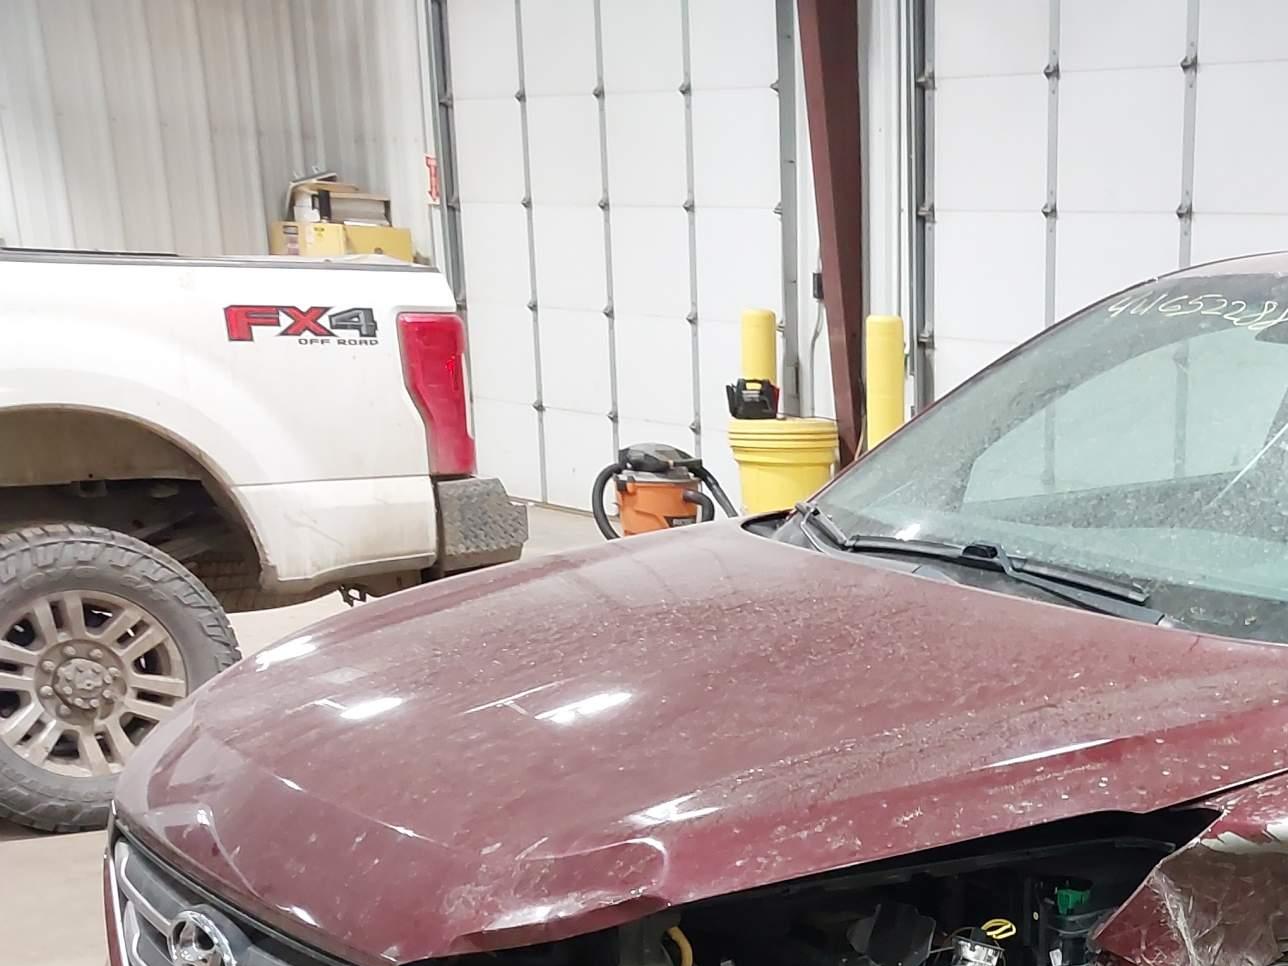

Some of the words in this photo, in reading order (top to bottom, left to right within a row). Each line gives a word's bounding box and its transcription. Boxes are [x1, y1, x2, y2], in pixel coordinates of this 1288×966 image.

[223, 304, 378, 342] FX4
[298, 338, 330, 346] OFF
[337, 338, 379, 346] ROAD
